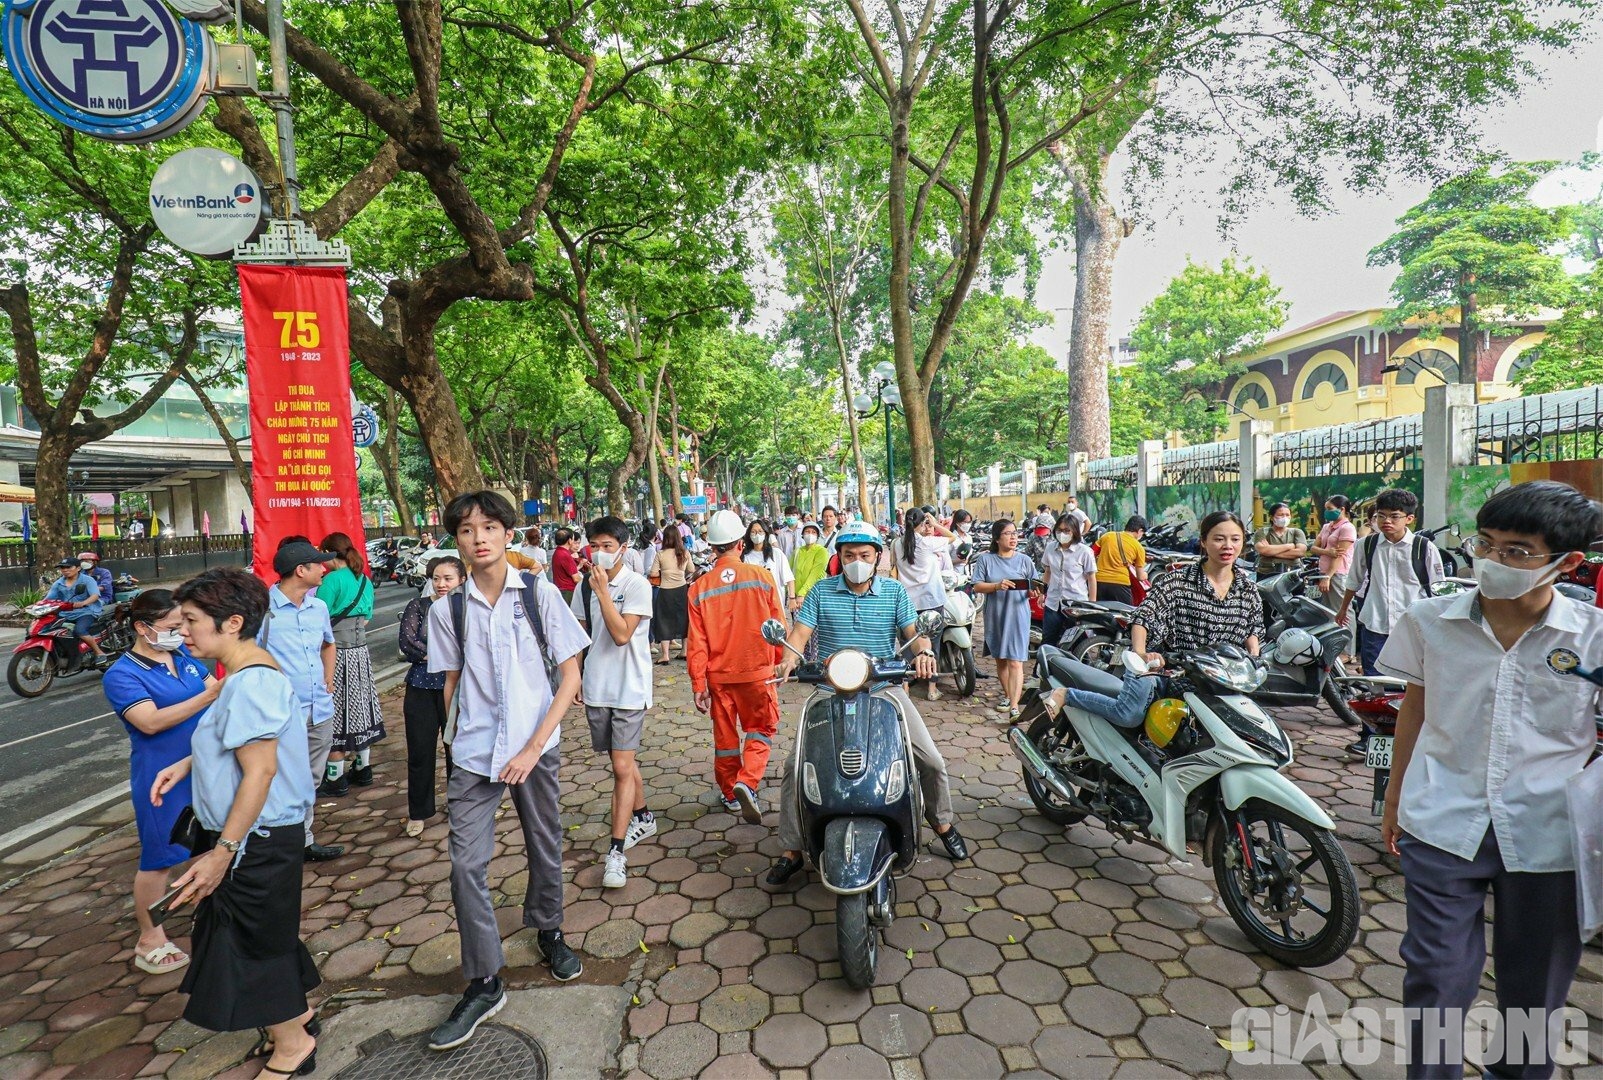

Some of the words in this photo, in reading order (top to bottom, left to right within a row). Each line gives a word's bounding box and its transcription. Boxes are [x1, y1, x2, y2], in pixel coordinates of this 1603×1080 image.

[90, 96, 105, 109] HÀ
[108, 96, 127, 111] NỘI
[152, 195, 236, 209] VietinBank
[272, 311, 320, 349] 75
[301, 352, 321, 361] 2023
[288, 385, 297, 396] THI
[298, 385, 315, 395] ĐUA
[274, 400, 289, 414] LẬP
[289, 399, 312, 412] THÀNH
[313, 400, 330, 412] TÍCH
[288, 415, 308, 428] MỪNG
[309, 417, 320, 428] 75
[321, 416, 338, 428] NĂM
[277, 432, 296, 444] NGÀY
[296, 429, 311, 443] CHỦ
[312, 433, 330, 446] TỊCH
[292, 447, 304, 459] CHÍ
[304, 449, 326, 459] MINH
[301, 463, 317, 475] KÊU
[318, 465, 331, 477] GỌI
[275, 481, 287, 492] THI
[287, 481, 300, 492] ĐUA
[301, 479, 309, 491] ÁI
[1212, 750, 1236, 763] HONDA
